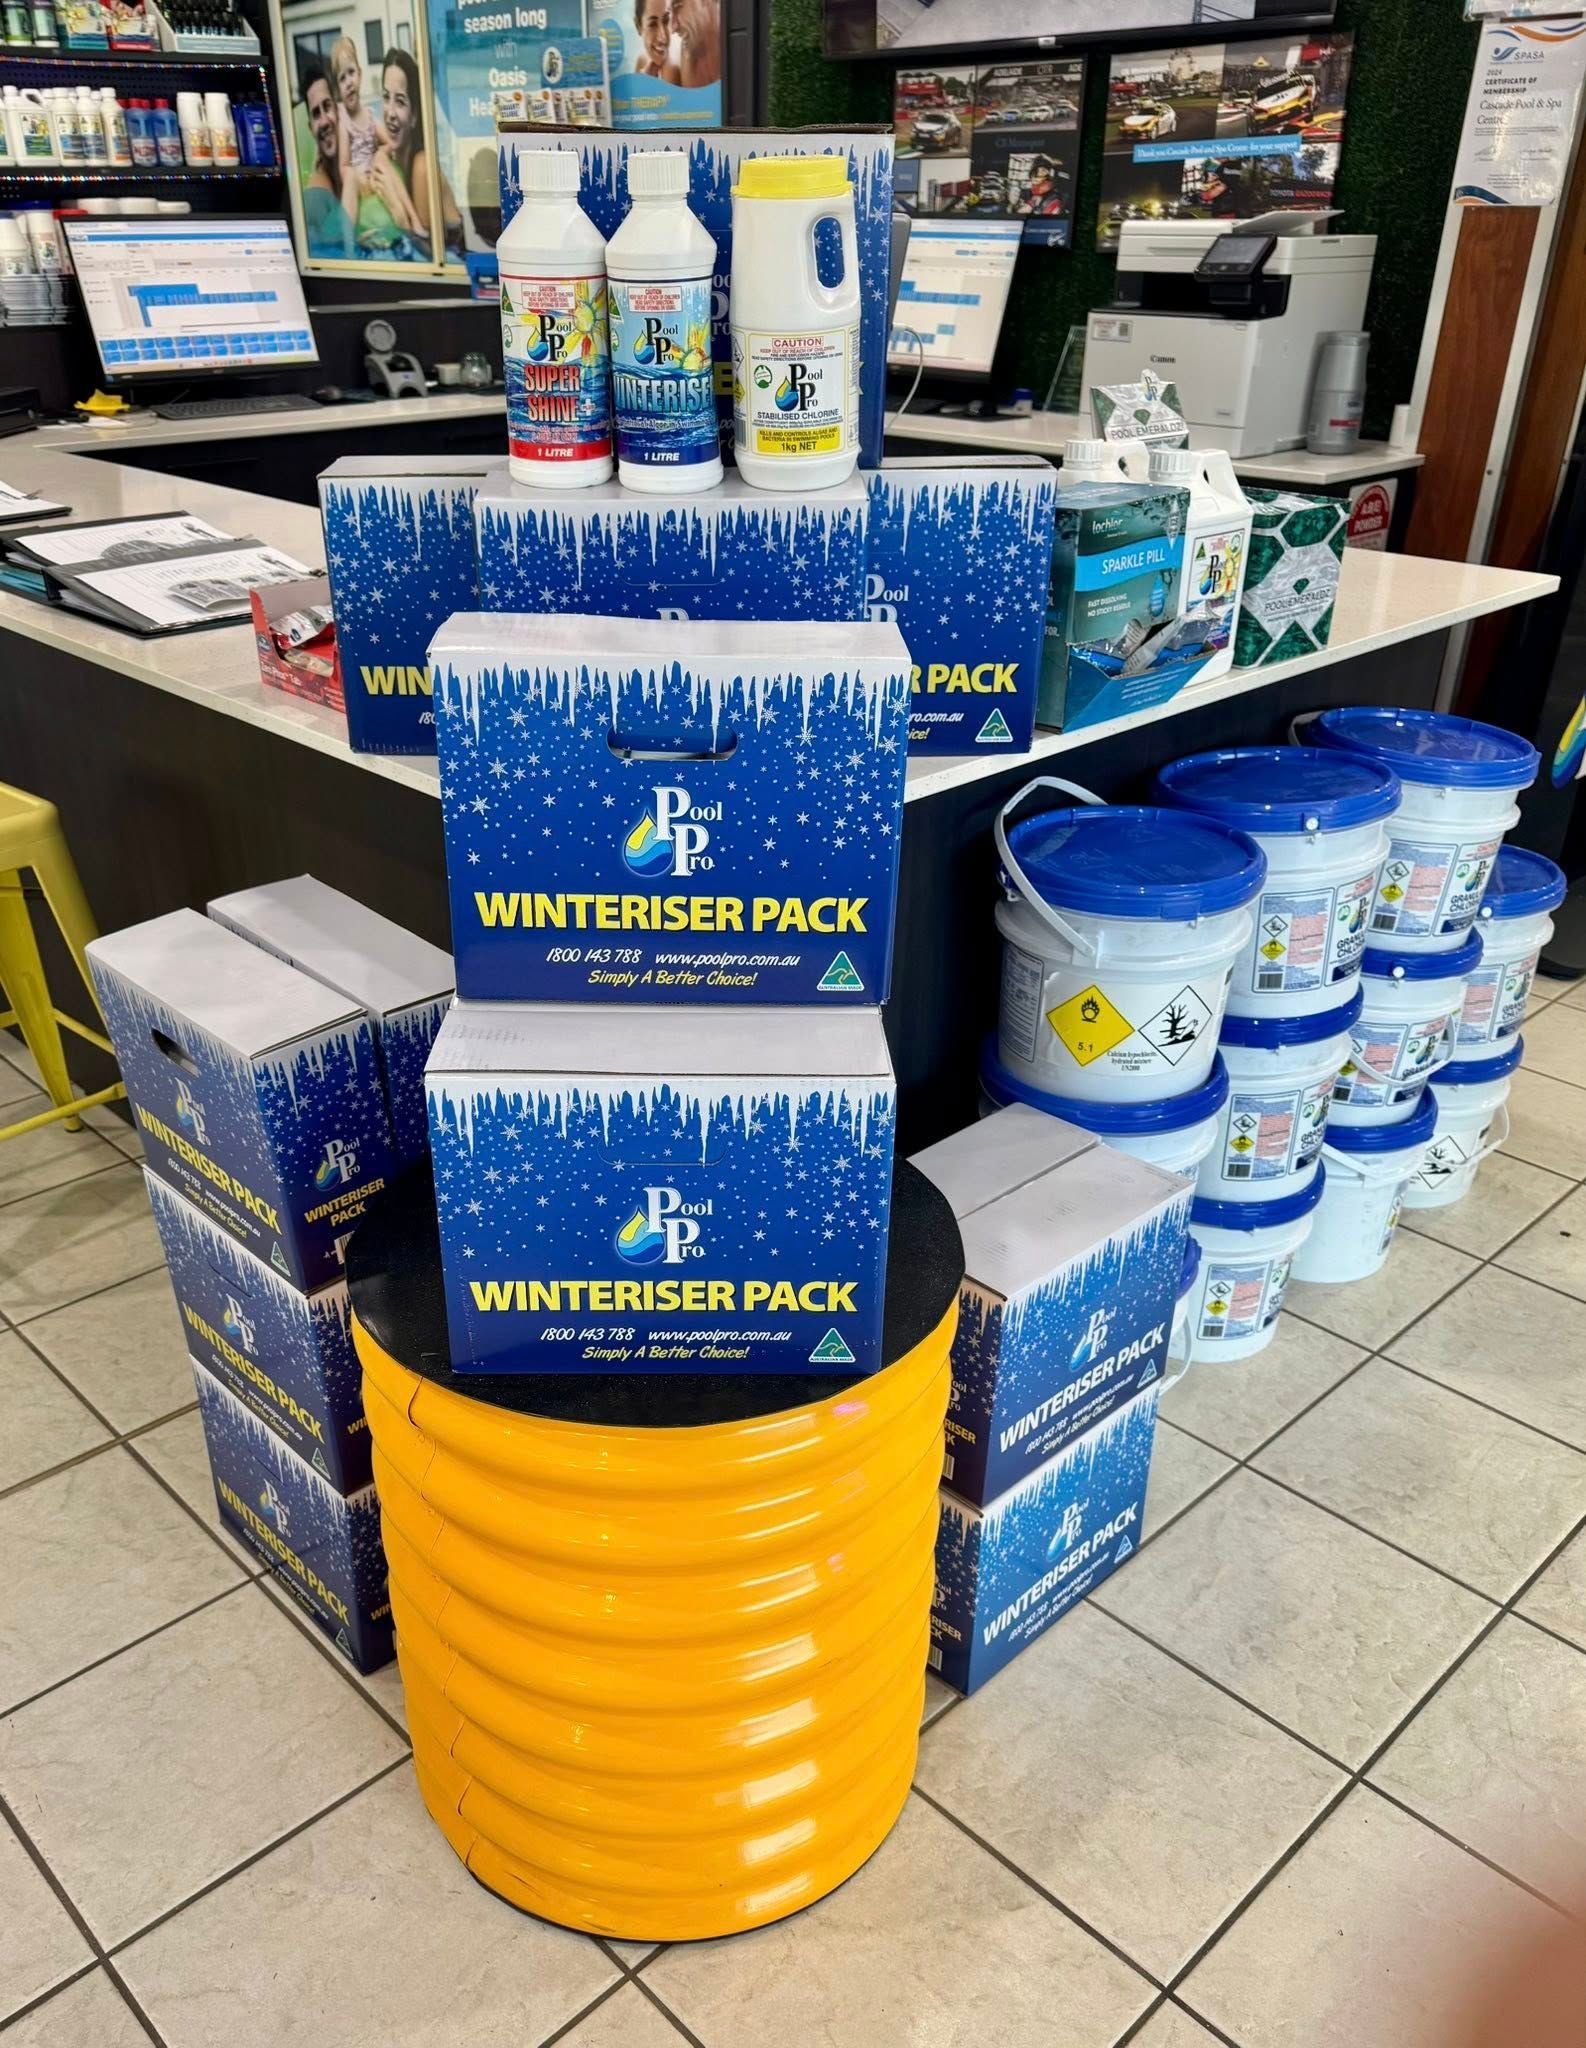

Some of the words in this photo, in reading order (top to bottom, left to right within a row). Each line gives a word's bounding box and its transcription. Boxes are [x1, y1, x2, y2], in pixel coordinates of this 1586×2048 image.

[464, 13, 512, 33] season
[515, 7, 547, 30] long
[1514, 51, 1545, 61] SPASA
[489, 66, 528, 88] Oasis
[1483, 87, 1527, 95] MEMBERSHIP
[1485, 77, 1526, 86] CERTIFICATE
[1515, 98, 1535, 110] Pool
[1537, 99, 1544, 107] &
[1548, 97, 1562, 111] Spa
[538, 314, 573, 343] Pool
[644, 317, 679, 346] Pool
[773, 337, 822, 348] CAUTION
[548, 333, 568, 362] Pro
[654, 336, 675, 365] Pro
[1150, 354, 1176, 364] Canon
[524, 365, 581, 392] SUPER
[788, 363, 823, 392] Pool
[527, 394, 579, 423] SHINE
[797, 382, 819, 412] Pro
[757, 412, 799, 420] STABILISED
[801, 409, 840, 420] CHLORINE
[537, 448, 542, 457] 1
[545, 448, 574, 457] LITRE
[644, 453, 649, 461] 1
[651, 453, 680, 461] LITRE
[782, 442, 797, 453] 1kg
[799, 441, 817, 450] NET
[1102, 552, 1145, 574] SPARKLE
[1147, 549, 1166, 564] PILL
[927, 663, 1019, 693] PACK
[651, 786, 723, 841] Pool
[670, 823, 715, 877] Pro
[474, 891, 744, 933] WINTERISER
[752, 896, 869, 934] PACK
[546, 948, 581, 964] 1800
[584, 948, 613, 964] 143
[614, 948, 642, 964] 788
[655, 951, 801, 967] www.poolpro.com.au
[588, 970, 638, 988] Simply
[641, 971, 652, 985] A
[655, 971, 703, 986] Better
[707, 972, 758, 987] Choice!
[1077, 1041, 1094, 1053] 5.1
[323, 1137, 361, 1170] Pool
[337, 1152, 361, 1184] Pro
[136, 1103, 233, 1196] WINTERISER
[233, 1179, 282, 1235] PACK
[304, 1178, 386, 1223] WINTERISER
[330, 1201, 367, 1227] PACK
[643, 1187, 713, 1234] Pool
[662, 1217, 706, 1264] Pro
[469, 1281, 736, 1312] WINTERISER
[744, 1281, 859, 1312] PACK
[541, 1327, 575, 1341] 1800
[578, 1327, 607, 1341] 143
[608, 1327, 636, 1341] 788
[648, 1329, 792, 1343] www.poolpro.com.au
[582, 1346, 632, 1361] Simply
[635, 1346, 647, 1359] A
[649, 1346, 697, 1359] Better
[699, 1346, 749, 1359] Choice!
[182, 1302, 279, 1401] WINTERISER
[278, 1387, 325, 1444] PACK
[951, 1379, 967, 1393] ool
[1000, 1358, 1114, 1453] WINTERISER
[1115, 1322, 1167, 1372] PACK
[217, 1476, 307, 1580] WINTERISER
[307, 1567, 350, 1627] PACK
[983, 1541, 1090, 1646] WINTERISER
[1091, 1501, 1138, 1554] PACK
